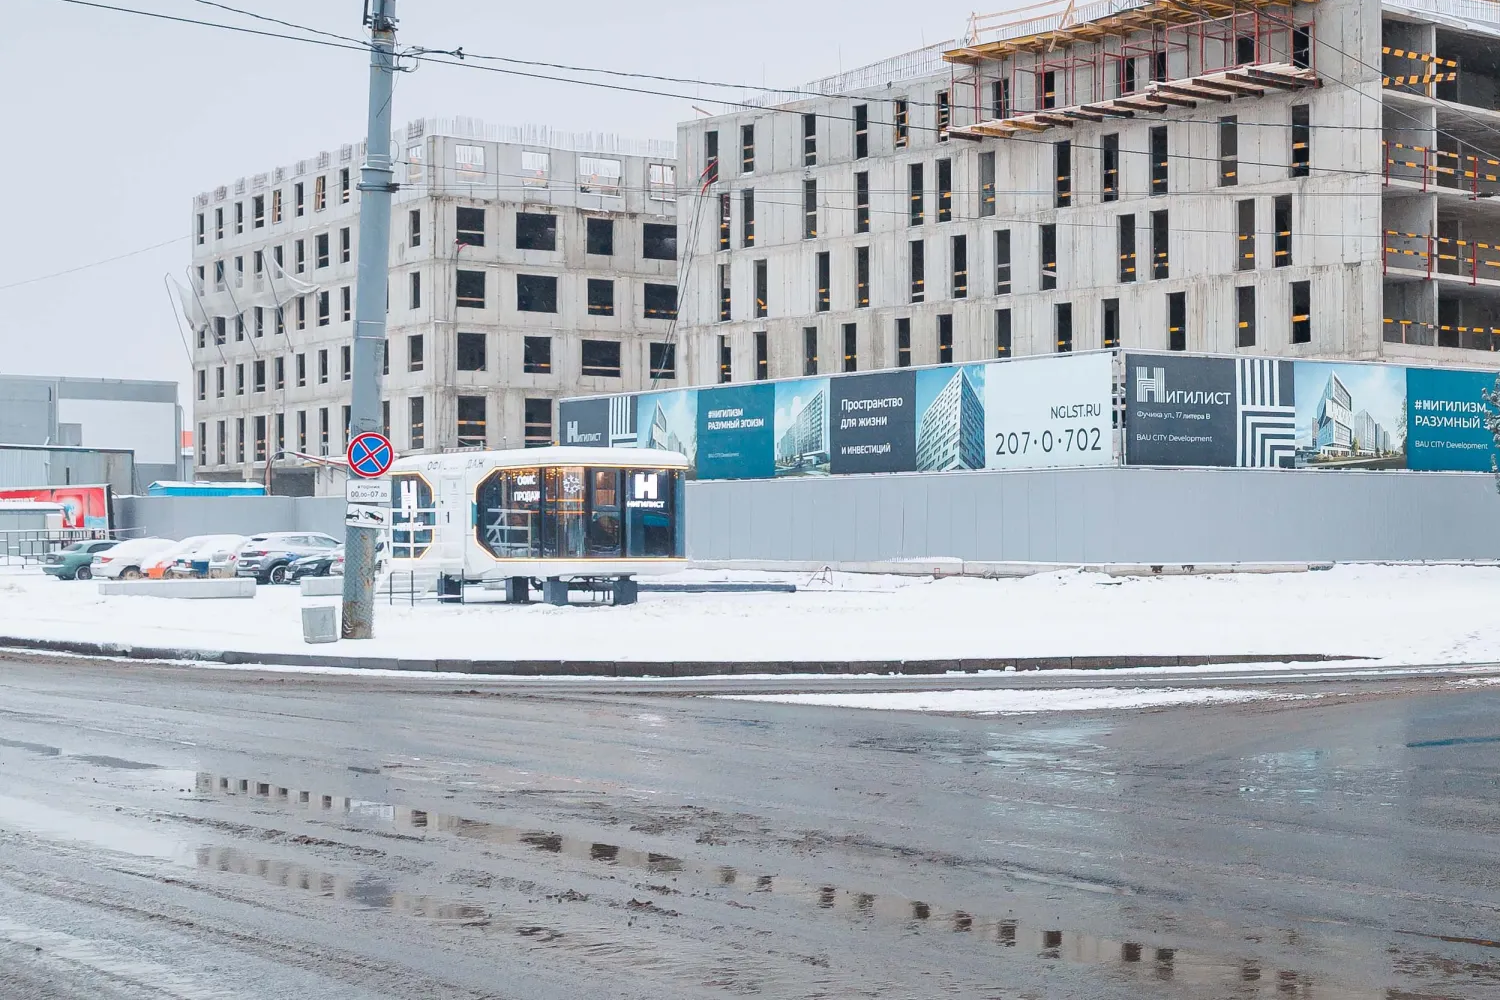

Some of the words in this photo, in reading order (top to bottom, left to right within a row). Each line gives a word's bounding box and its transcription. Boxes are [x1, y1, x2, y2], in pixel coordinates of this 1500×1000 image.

[841, 397, 904, 413] Пространство
[1050, 403, 1101, 420] NGLST.RU
[840, 419, 857, 430] для
[858, 416, 888, 427] жизни
[1415, 415, 1480, 429] РАЗУМНЫЙ
[1136, 434, 1151, 442] BAU
[1152, 434, 1168, 442] CITY
[1168, 435, 1213, 444] Development
[1414, 440, 1430, 448] BAU
[1431, 441, 1445, 449] CITY
[1446, 441, 1488, 451] Development
